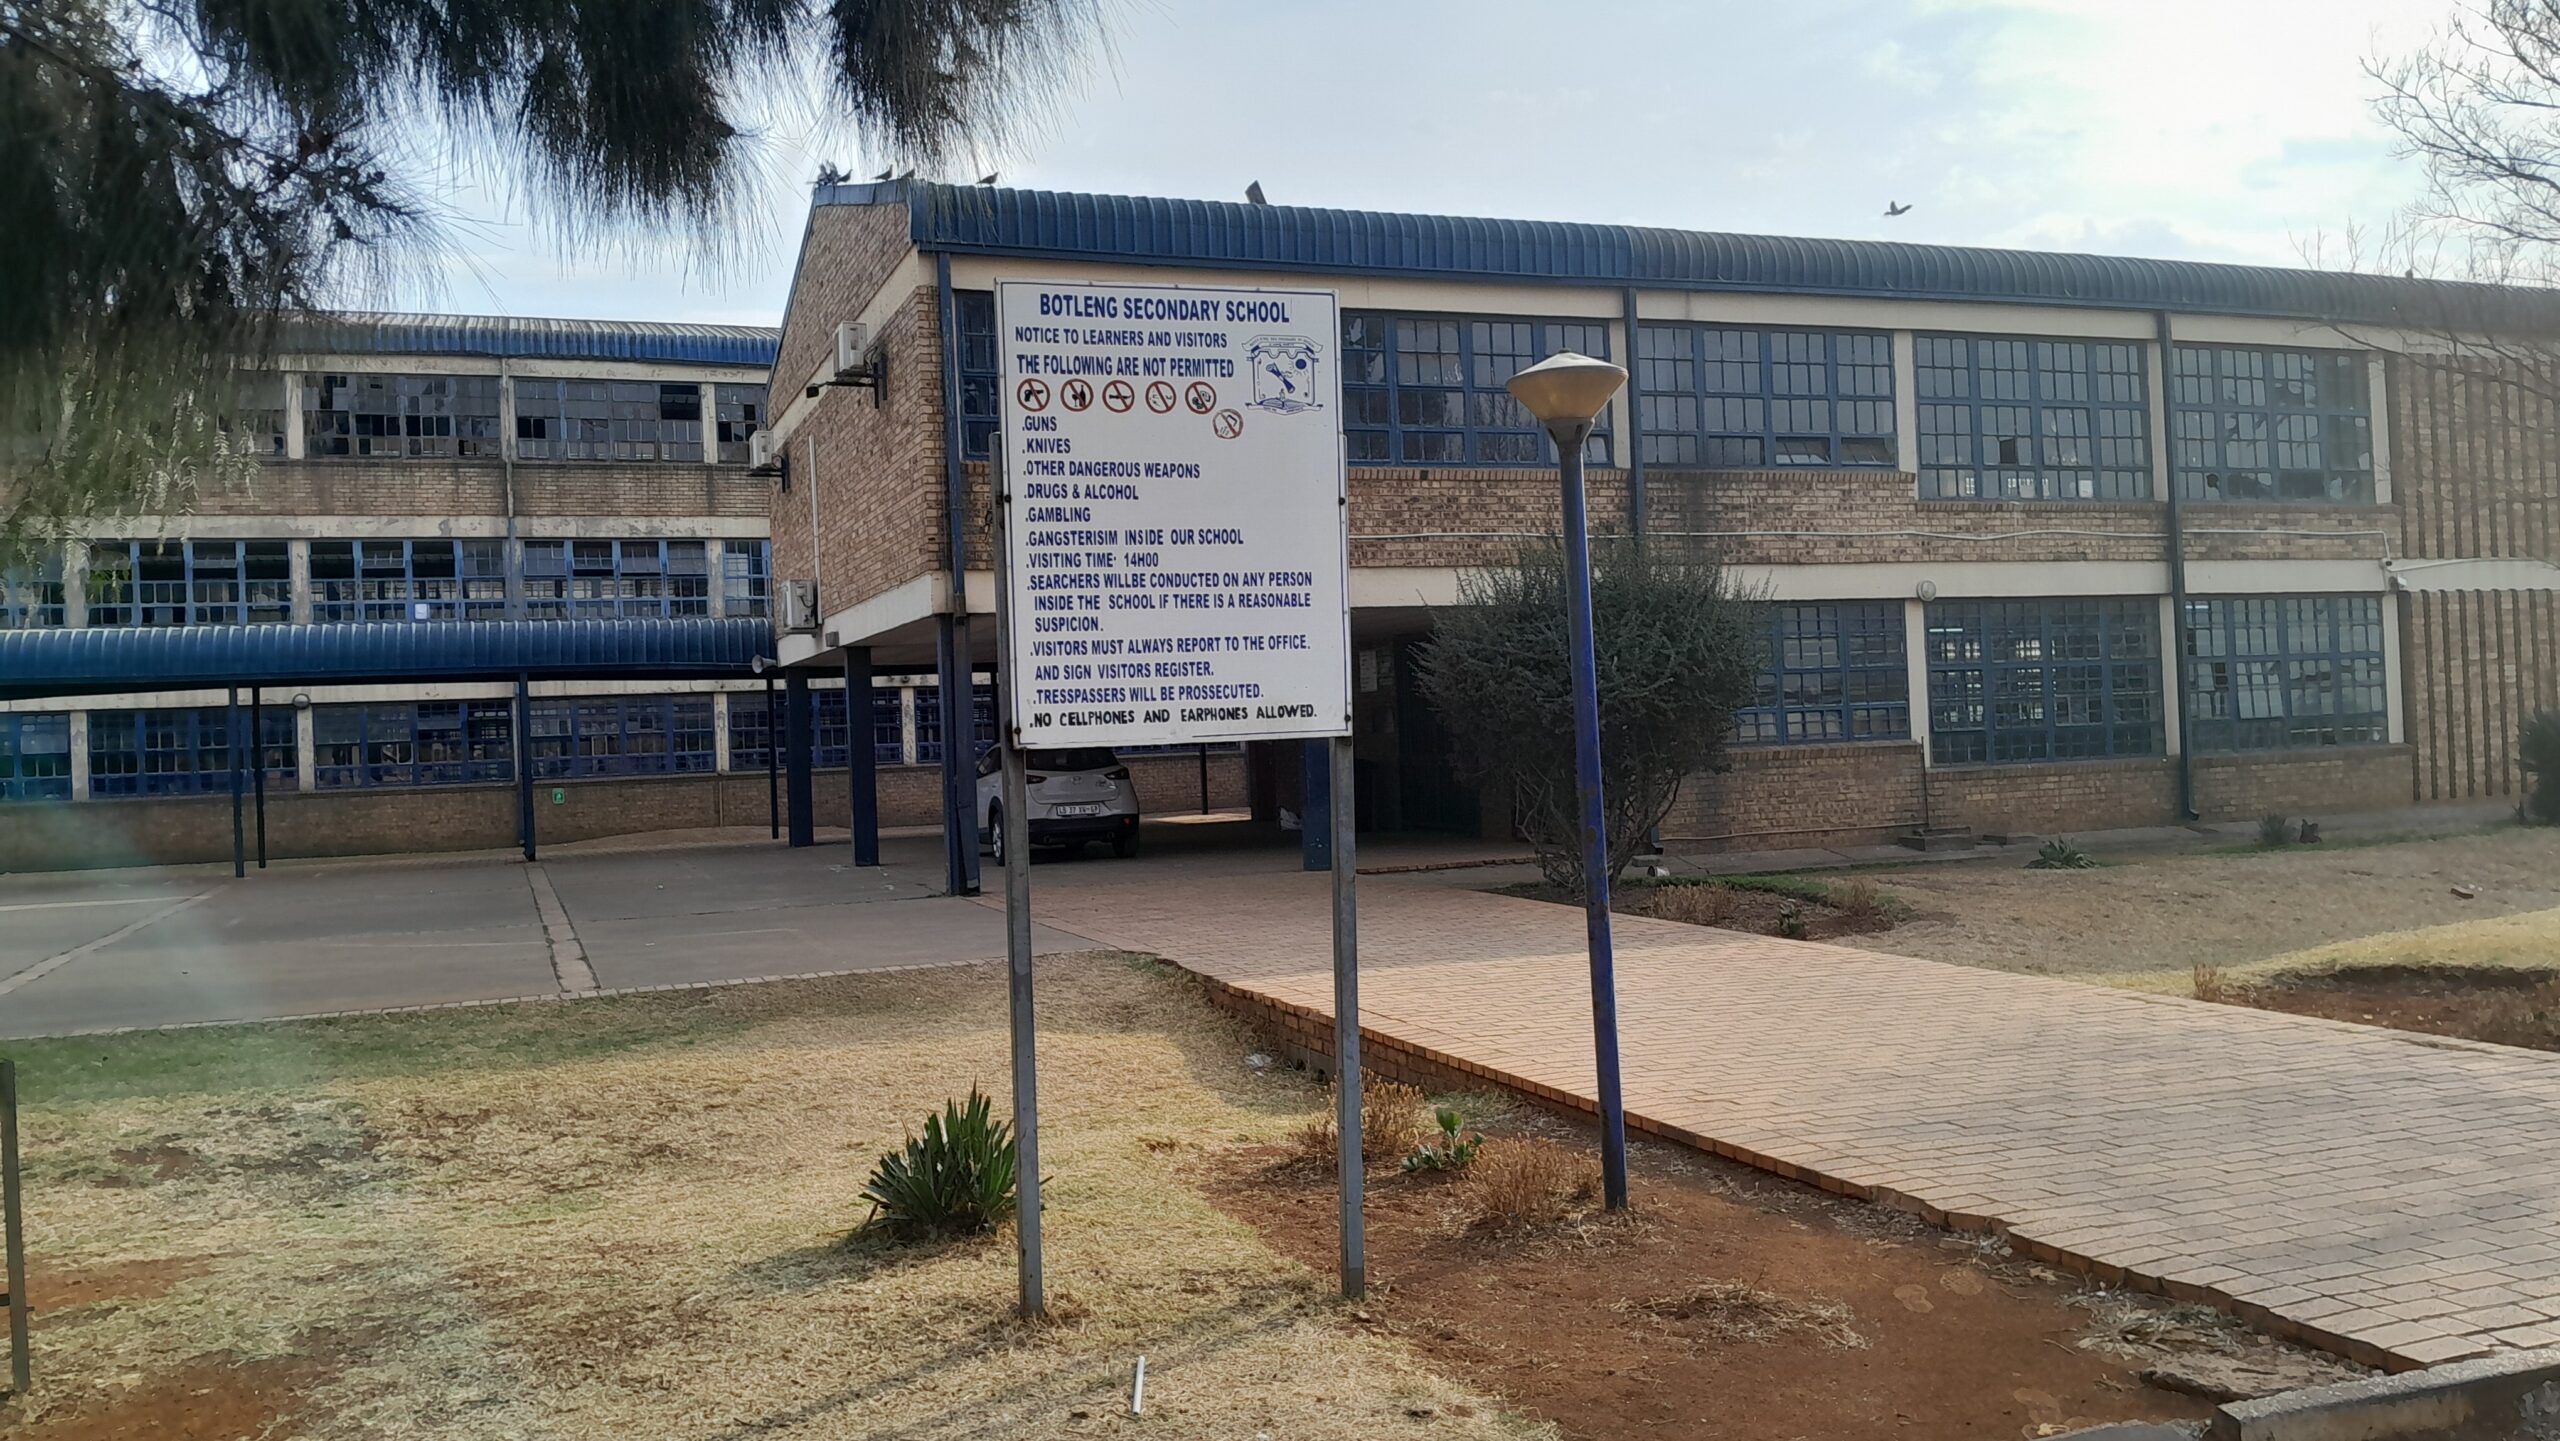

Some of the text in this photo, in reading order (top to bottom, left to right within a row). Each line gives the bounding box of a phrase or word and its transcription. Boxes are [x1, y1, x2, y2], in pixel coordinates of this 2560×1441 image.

[1040, 293, 1290, 323] BOTLENG SECONDARY SCHOOL
[1015, 326, 1228, 348] NOTICE TO LEARNERS AND VISITORS
[1016, 354, 1234, 378] THE FOLLOWING ARE NOT PERMITTED
[1069, 461, 1141, 478] DANGEROUS
[1143, 462, 1200, 479] WEAPONS
[1071, 484, 1081, 500] &
[1084, 485, 1139, 500] ALCOHOL
[1124, 529, 1164, 546] INSIDE
[1170, 529, 1195, 546] OUR
[1198, 528, 1244, 545] SCHOOL
[1123, 552, 1159, 568] 14H00
[1150, 572, 1220, 588] CONDUCTED
[1223, 572, 1239, 587] ON
[1242, 572, 1265, 587] ANY
[1268, 571, 1312, 587] PERSON
[1034, 592, 1311, 611] INSIDE THE SCHOOL IF THERE IS A REASONABLE
[1091, 639, 1124, 655] MUST
[1127, 637, 1174, 654] ALWAYS
[1177, 637, 1221, 653] REPORT
[1224, 636, 1239, 651] TO
[1242, 635, 1265, 651] THE
[1268, 634, 1311, 650] OFFICE.
[1034, 661, 1214, 681] AND SIGN VISITORS REGISTER.
[1129, 686, 1157, 702] WILL
[1160, 686, 1175, 701] BE
[1178, 683, 1264, 701] PROSSECUTED.
[1059, 710, 1135, 727] CELLPHONES
[1143, 708, 1170, 723] AND
[1180, 707, 1248, 722] EARPHONES
[1256, 703, 1317, 719] ALLOWED.
